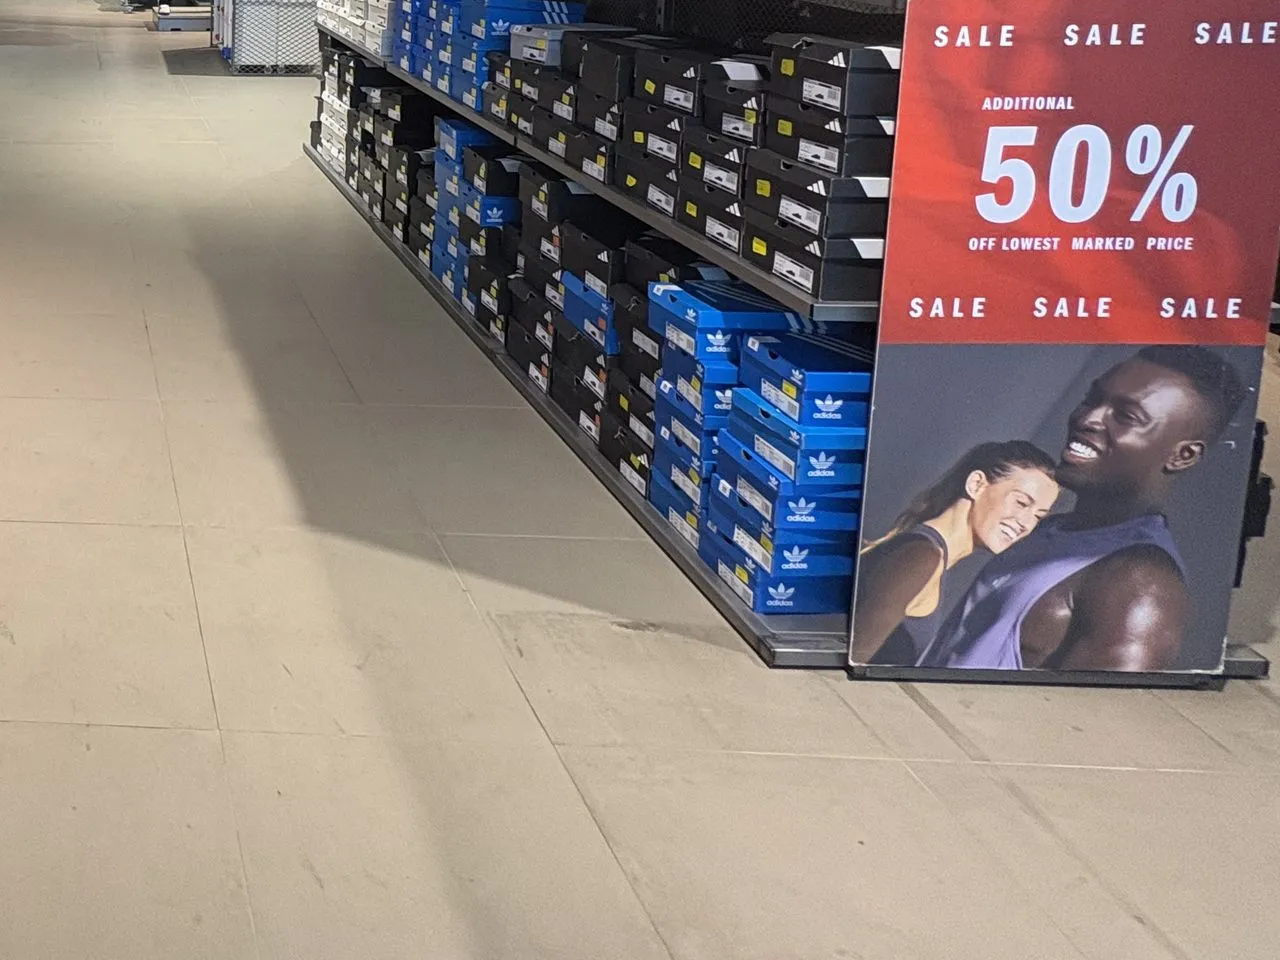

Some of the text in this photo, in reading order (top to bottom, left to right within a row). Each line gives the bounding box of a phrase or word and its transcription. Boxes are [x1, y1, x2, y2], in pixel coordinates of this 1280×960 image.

[934, 21, 1278, 48] SALE SALE SALE
[982, 96, 1075, 111] ADDITIONAL
[974, 124, 1198, 224] 50%
[969, 237, 1194, 251] OFF LOWEST MARKED PRICE
[909, 297, 1242, 319] SALE SALE SALE
[706, 345, 731, 353] adidas
[812, 411, 842, 420] adidas
[807, 469, 835, 477] adidas
[786, 513, 816, 522] adidas
[781, 561, 808, 570] adidas
